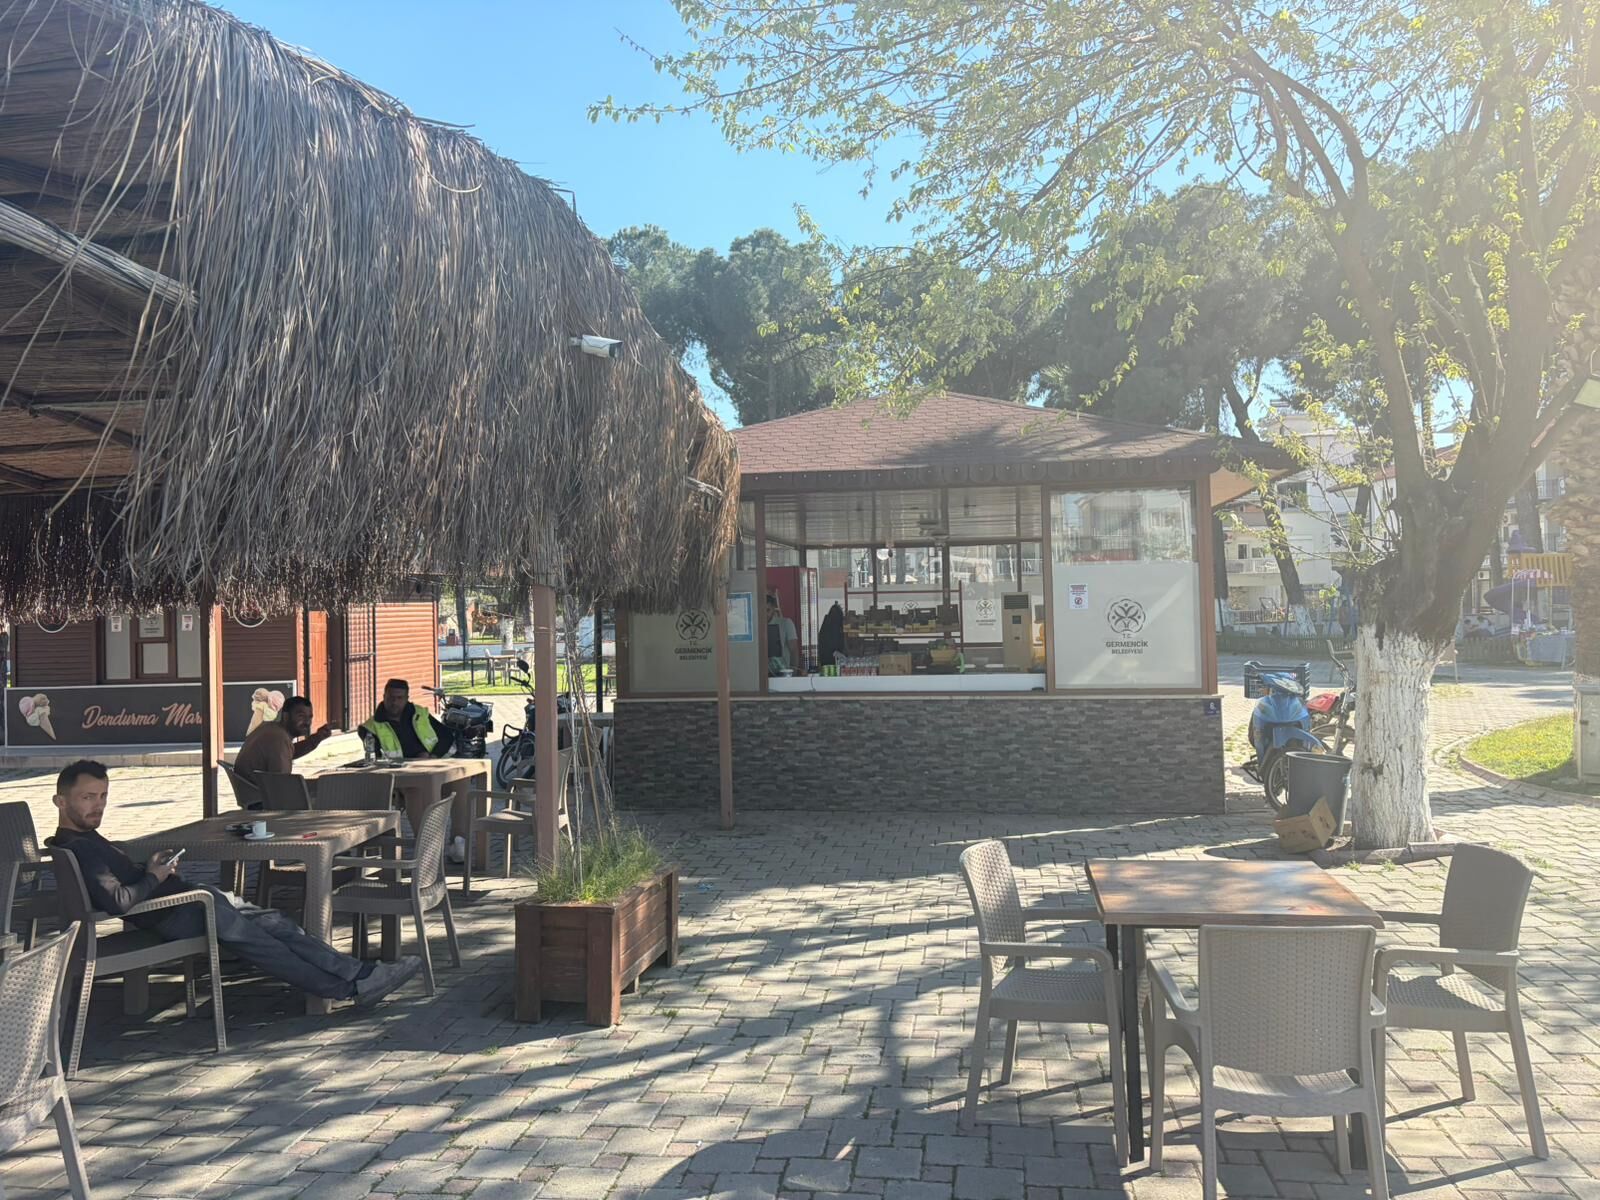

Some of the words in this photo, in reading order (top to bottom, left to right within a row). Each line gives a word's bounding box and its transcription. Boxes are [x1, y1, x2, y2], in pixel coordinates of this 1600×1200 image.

[1105, 640, 1149, 648] GERMENCİK
[81, 705, 159, 729] Dondurma
[161, 702, 203, 728] Mar
